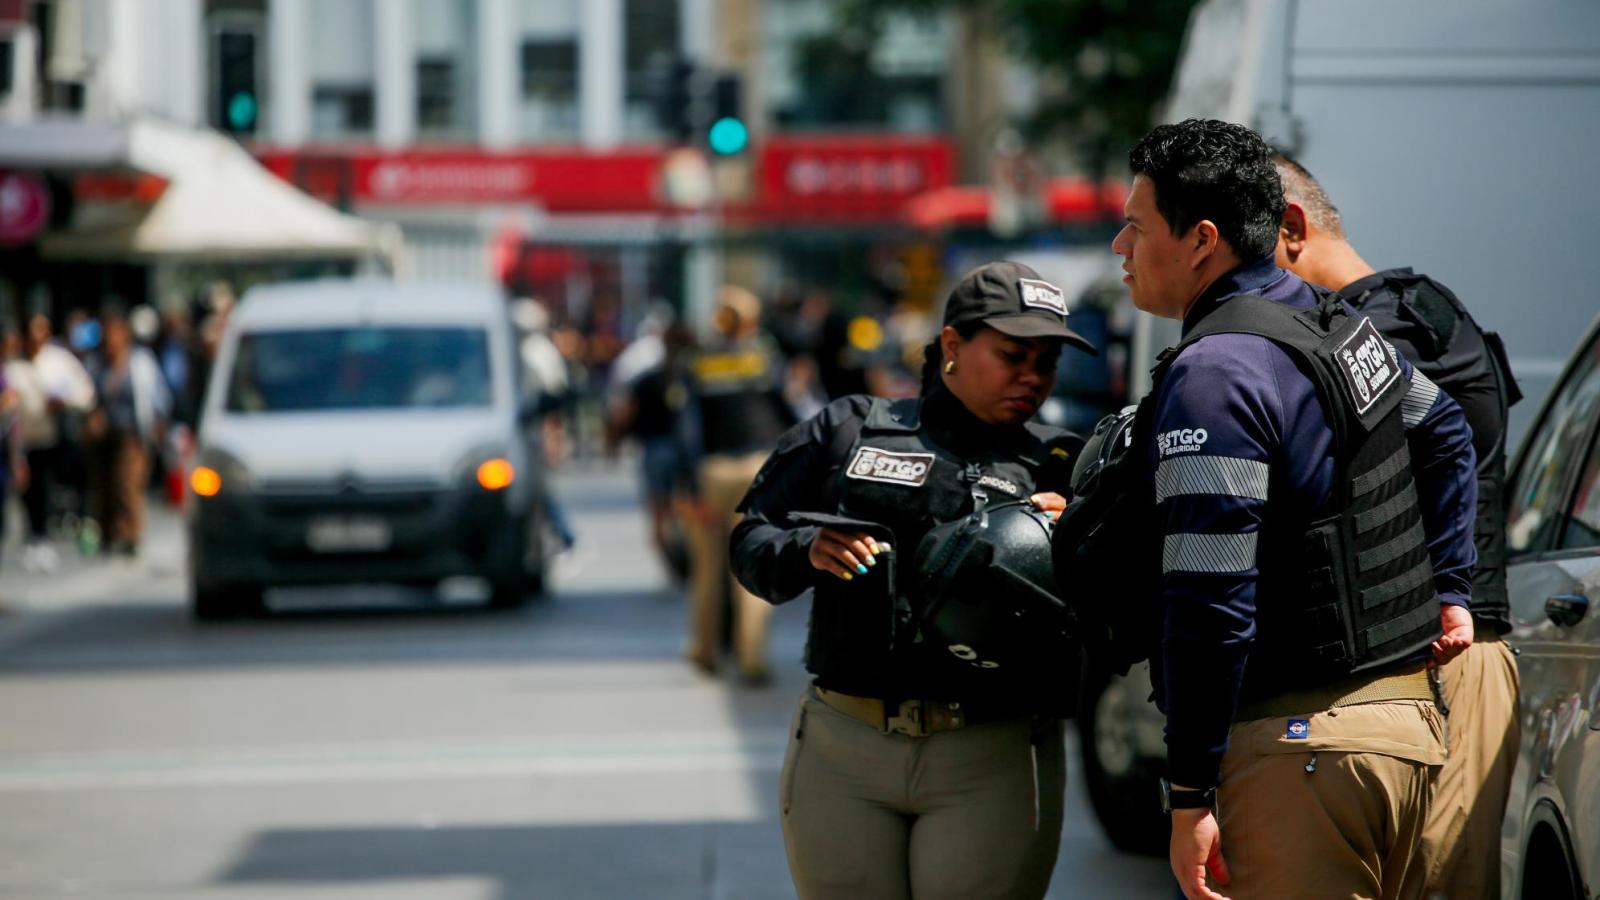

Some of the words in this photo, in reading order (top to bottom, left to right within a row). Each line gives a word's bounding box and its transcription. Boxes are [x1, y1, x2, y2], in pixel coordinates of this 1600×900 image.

[1355, 334, 1386, 379] STGO
[1165, 428, 1208, 448] STGO
[1165, 445, 1200, 455] SEGURIDAD
[874, 457, 926, 476] STGO
